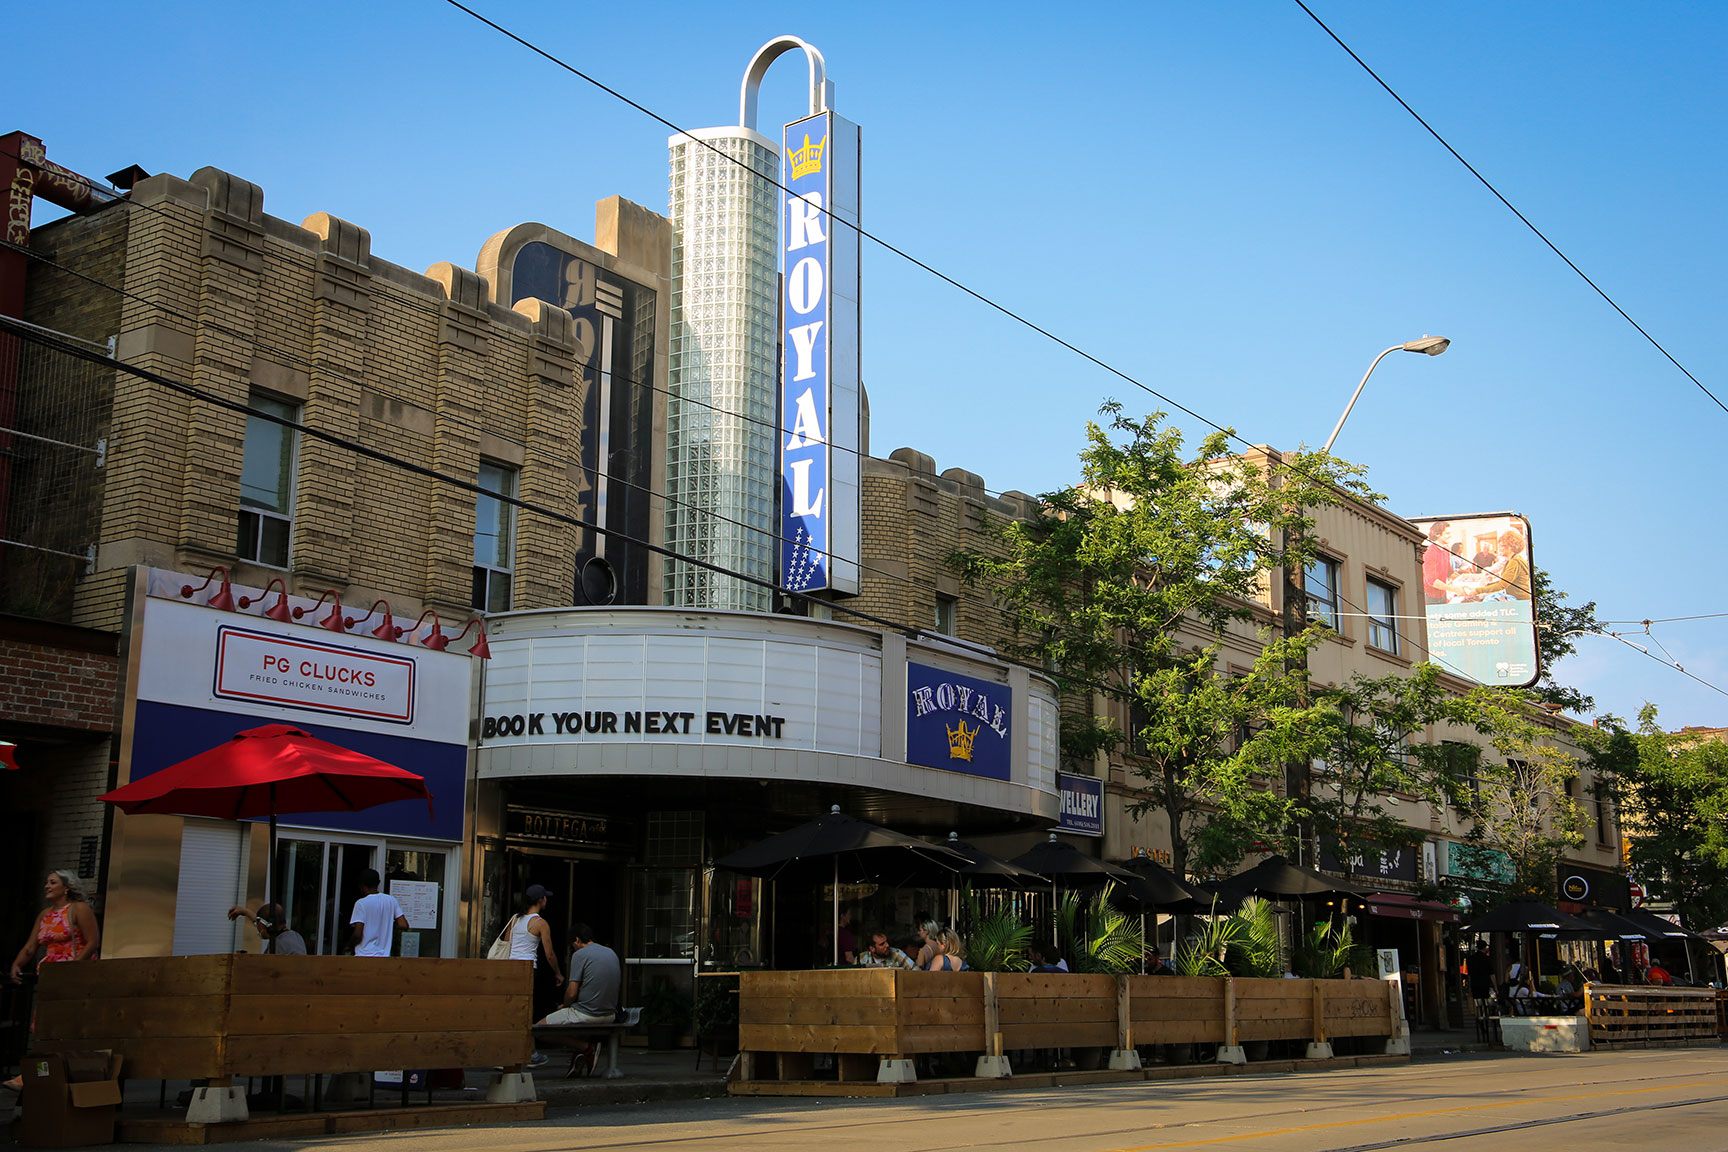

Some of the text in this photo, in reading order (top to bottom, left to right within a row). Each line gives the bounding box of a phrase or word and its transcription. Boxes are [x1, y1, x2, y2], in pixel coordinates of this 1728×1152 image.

[786, 191, 827, 519] ROYAL
[1445, 612, 1468, 620] some
[1469, 609, 1498, 618] added
[1500, 608, 1519, 616] TLC.
[1454, 620, 1489, 629] Gaming
[1433, 630, 1467, 639] Centres
[1469, 629, 1503, 637] support
[1505, 626, 1517, 635] all
[1433, 640, 1442, 648] of
[1444, 639, 1465, 647] local
[1466, 638, 1500, 647] Toronto
[263, 654, 376, 687] PG CLUCKS
[249, 674, 386, 702] FRIED CHICKEN SANDWICHES
[912, 682, 1008, 739] ROYAL
[483, 711, 785, 739] BOOK YOUR NEXT EVENT
[524, 815, 588, 839] BOTTEGA
